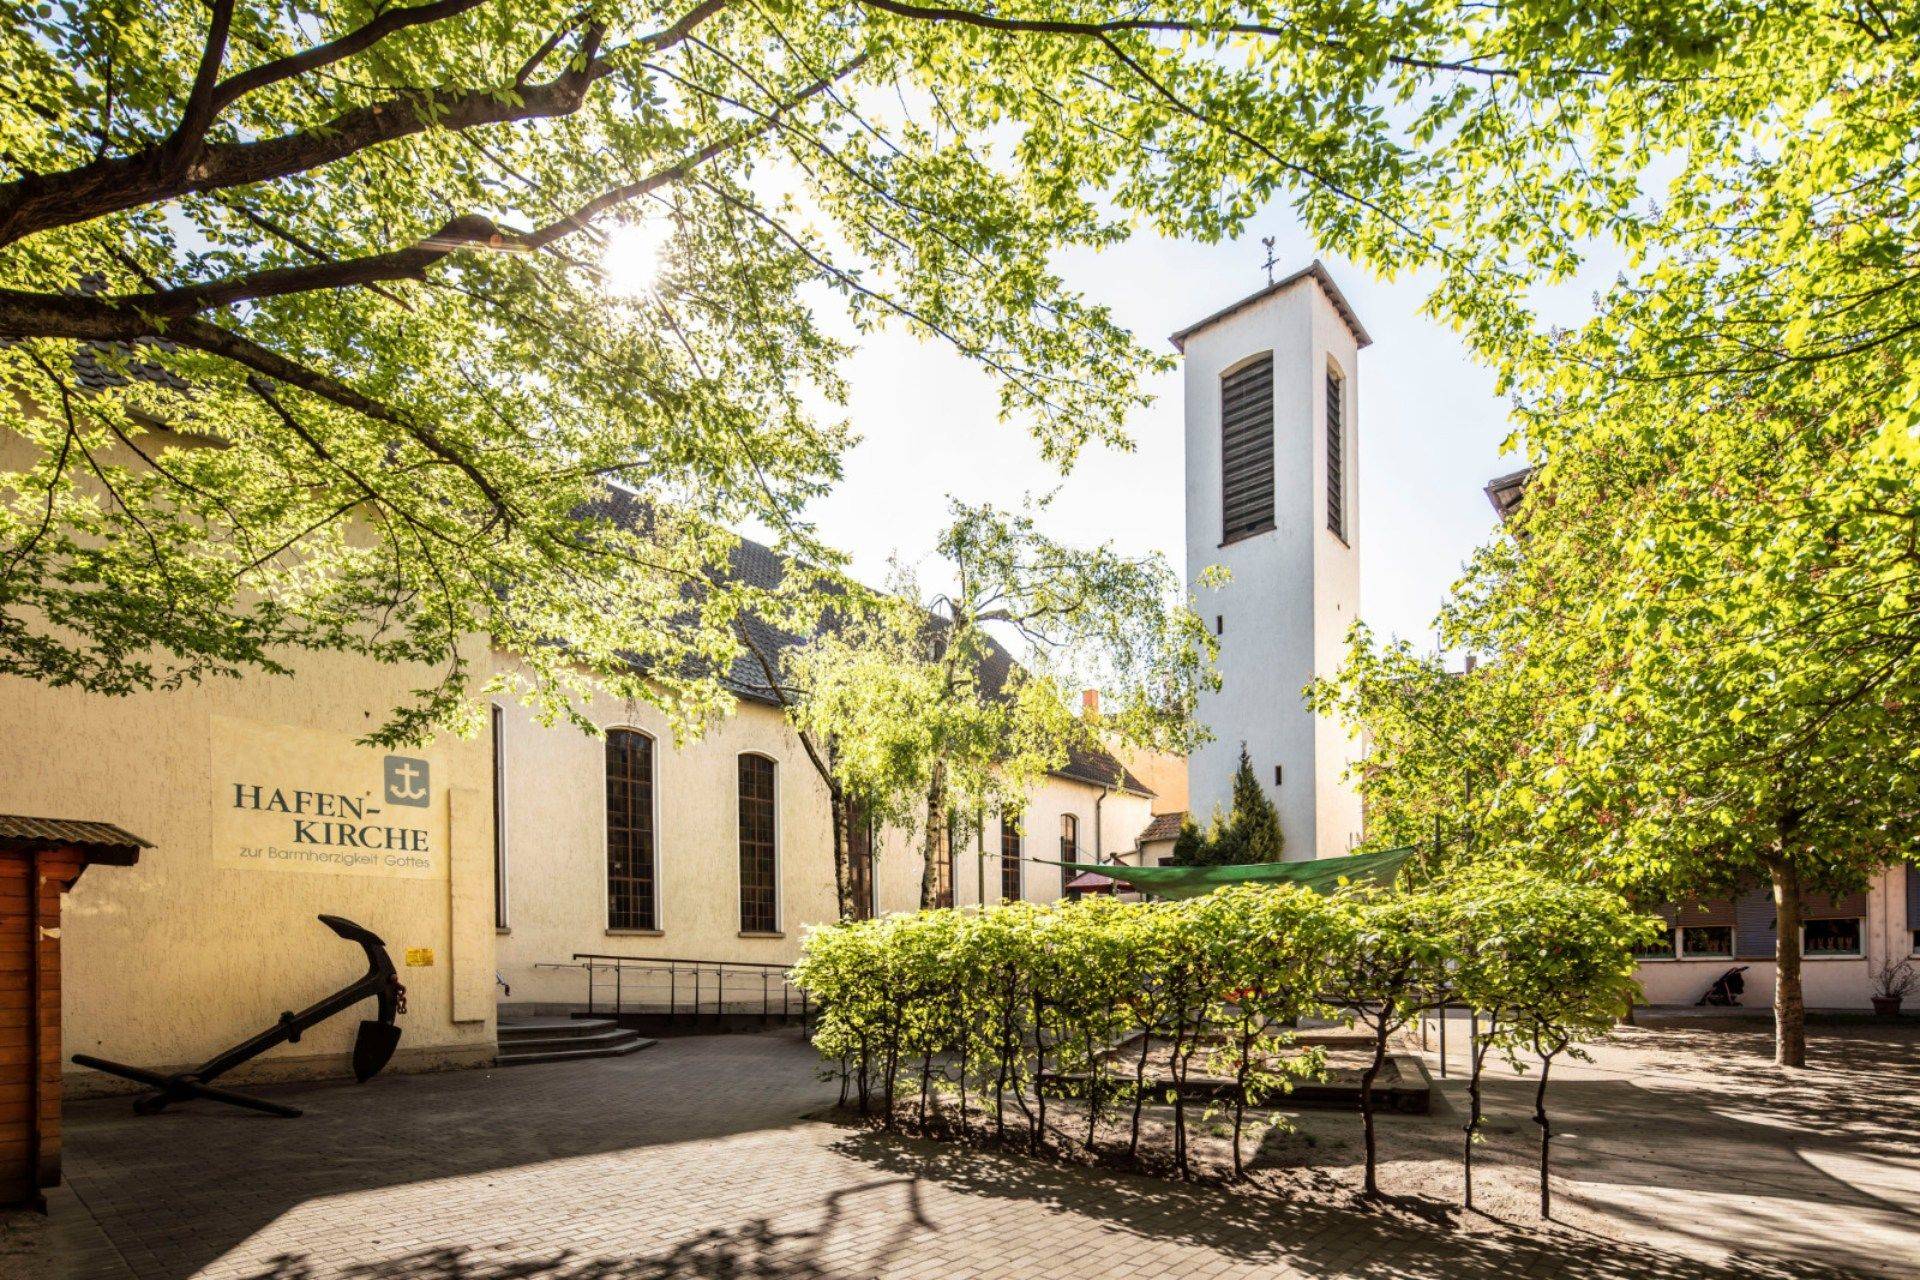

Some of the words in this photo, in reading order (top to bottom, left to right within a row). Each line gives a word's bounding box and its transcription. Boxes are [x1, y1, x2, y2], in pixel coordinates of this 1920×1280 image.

[233, 783, 381, 820] HAFEN-
[293, 820, 430, 852] KIRCHE
[240, 847, 262, 858] zur
[268, 847, 378, 866] Barmherzigkeit
[384, 854, 430, 868] Gottes
